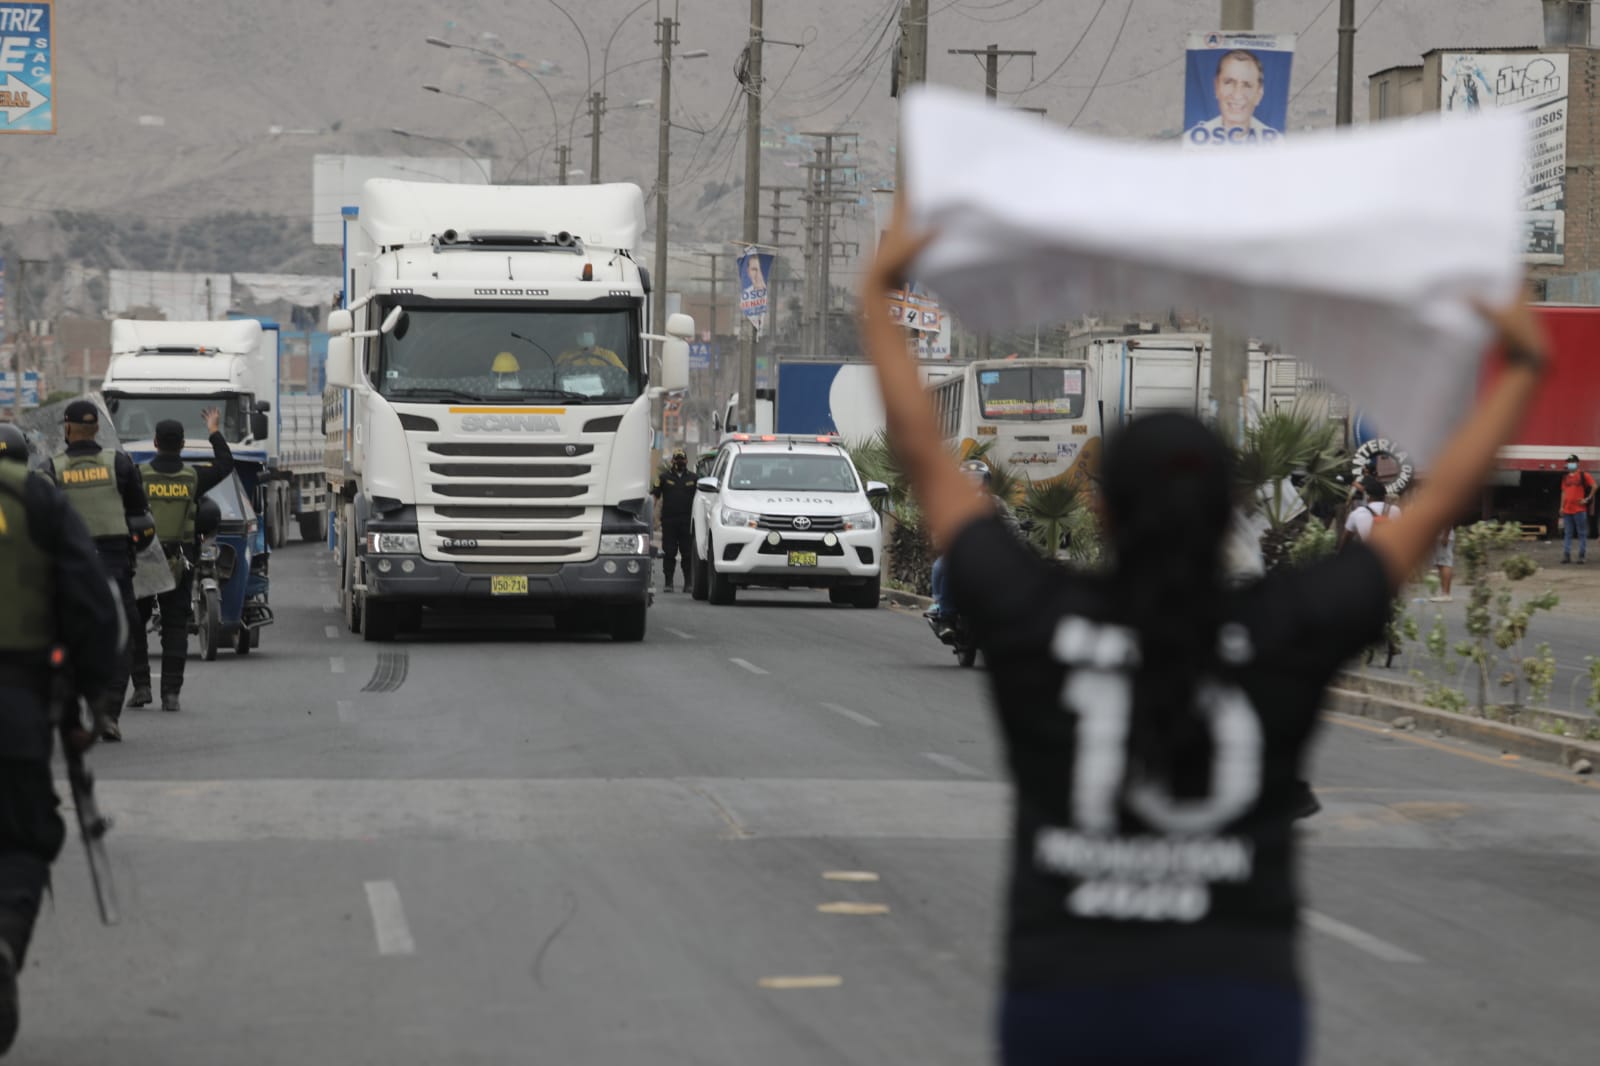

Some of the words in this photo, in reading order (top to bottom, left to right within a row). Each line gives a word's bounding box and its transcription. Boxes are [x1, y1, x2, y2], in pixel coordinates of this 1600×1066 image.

[1529, 164, 1565, 184] VINILES
[461, 415, 560, 432] SCANIA
[63, 467, 109, 483] POLICIA
[149, 484, 189, 497] POLICIA
